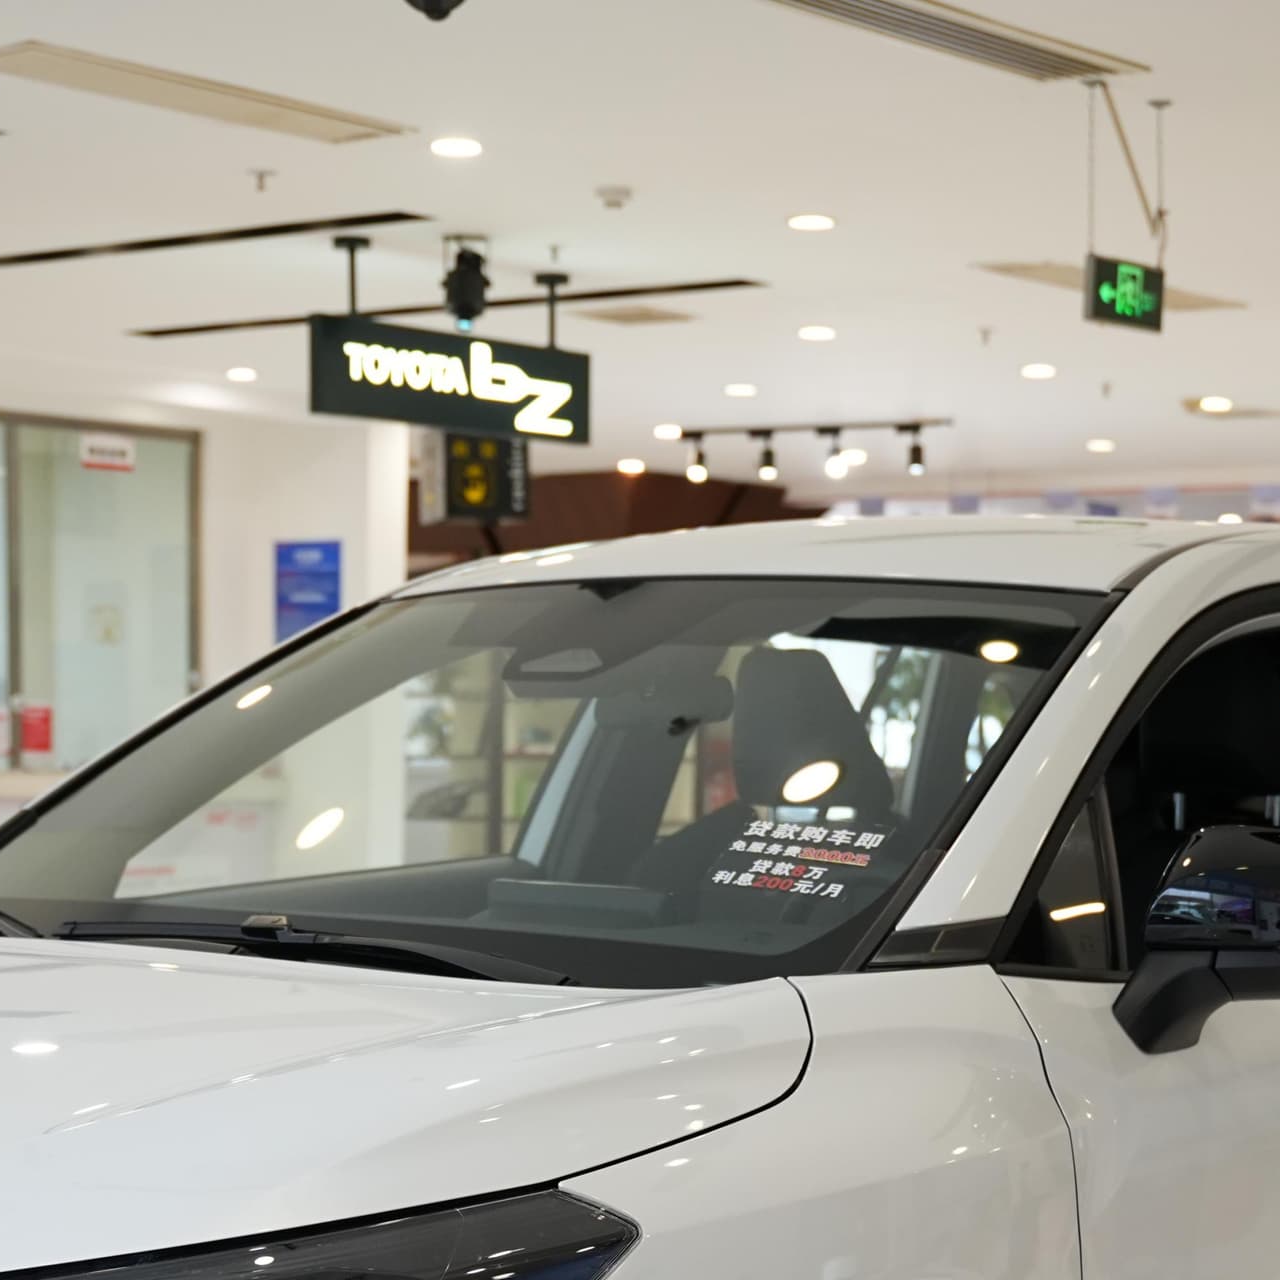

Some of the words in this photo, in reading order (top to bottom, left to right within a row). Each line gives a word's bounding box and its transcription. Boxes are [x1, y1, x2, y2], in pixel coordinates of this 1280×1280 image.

[343, 341, 470, 396] TOYOTA
[743, 820, 886, 849] 贷款购车即
[711, 870, 845, 898] 利息200元/月
